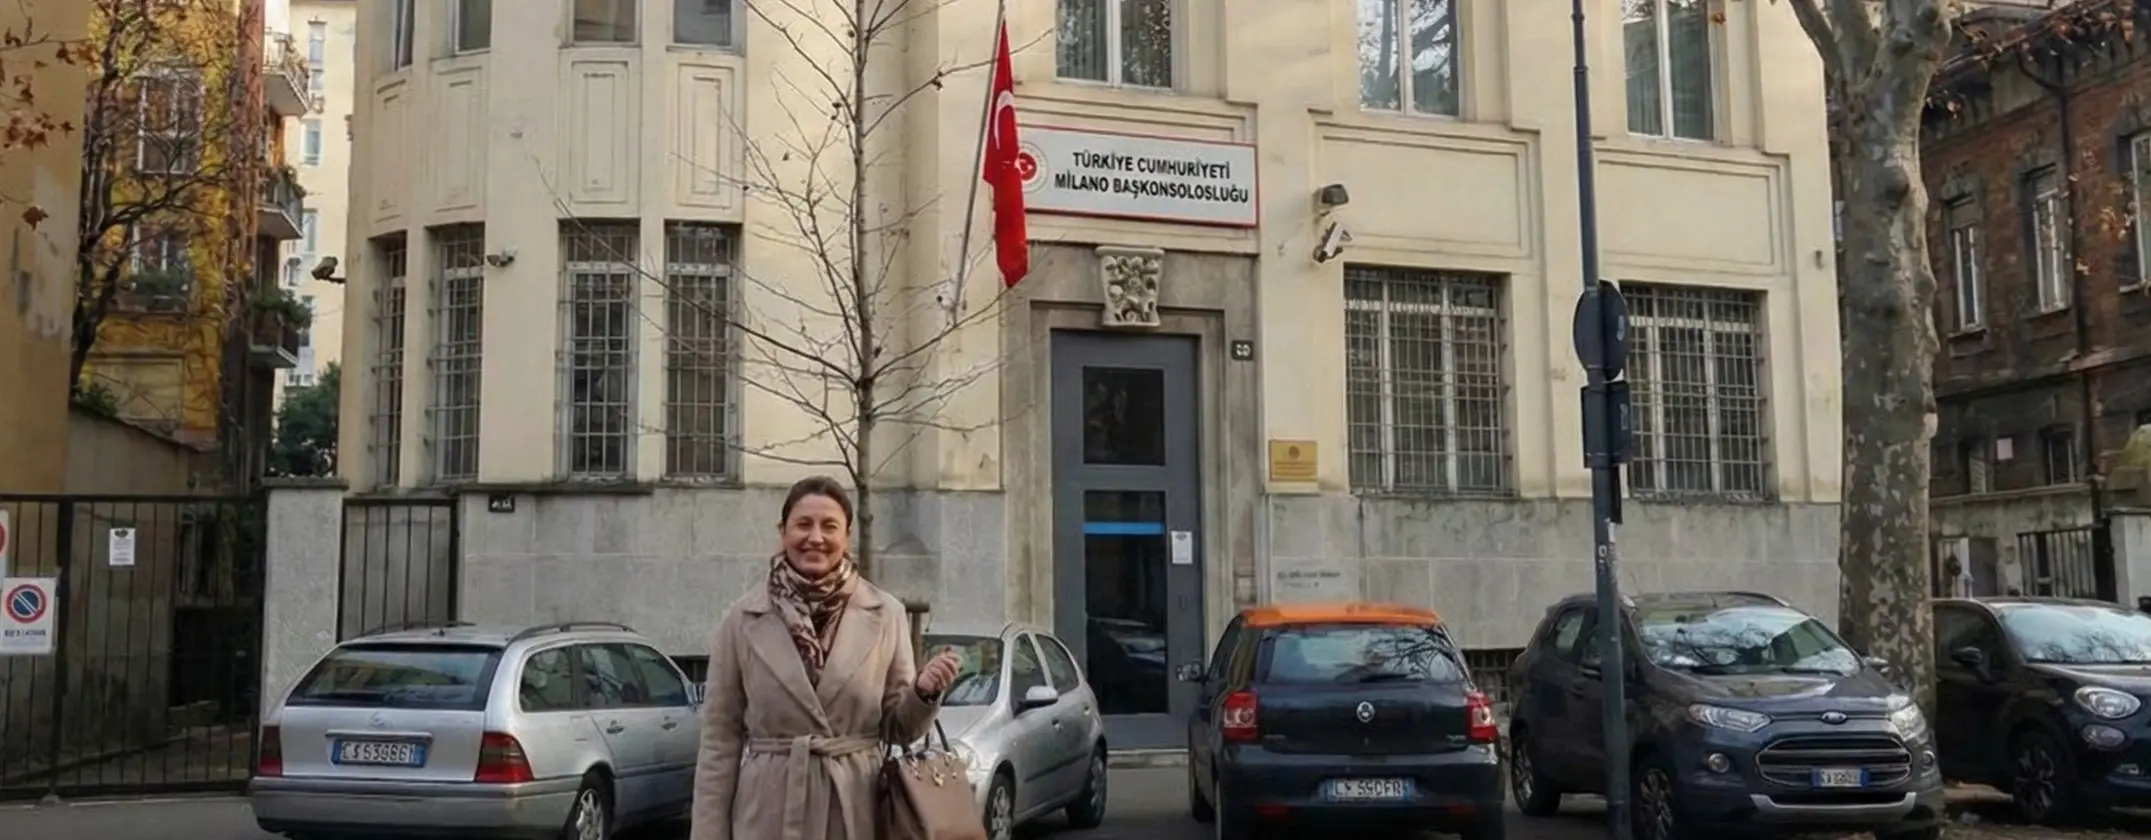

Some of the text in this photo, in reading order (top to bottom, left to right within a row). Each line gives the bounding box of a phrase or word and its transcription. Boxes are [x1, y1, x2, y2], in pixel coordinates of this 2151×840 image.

[1072, 149, 1134, 172] TÜRKİYE
[1137, 157, 1231, 180] CUMHURİYETİ
[1054, 170, 1249, 204] MİLANO BAŞKONSOLOSLUĞU
